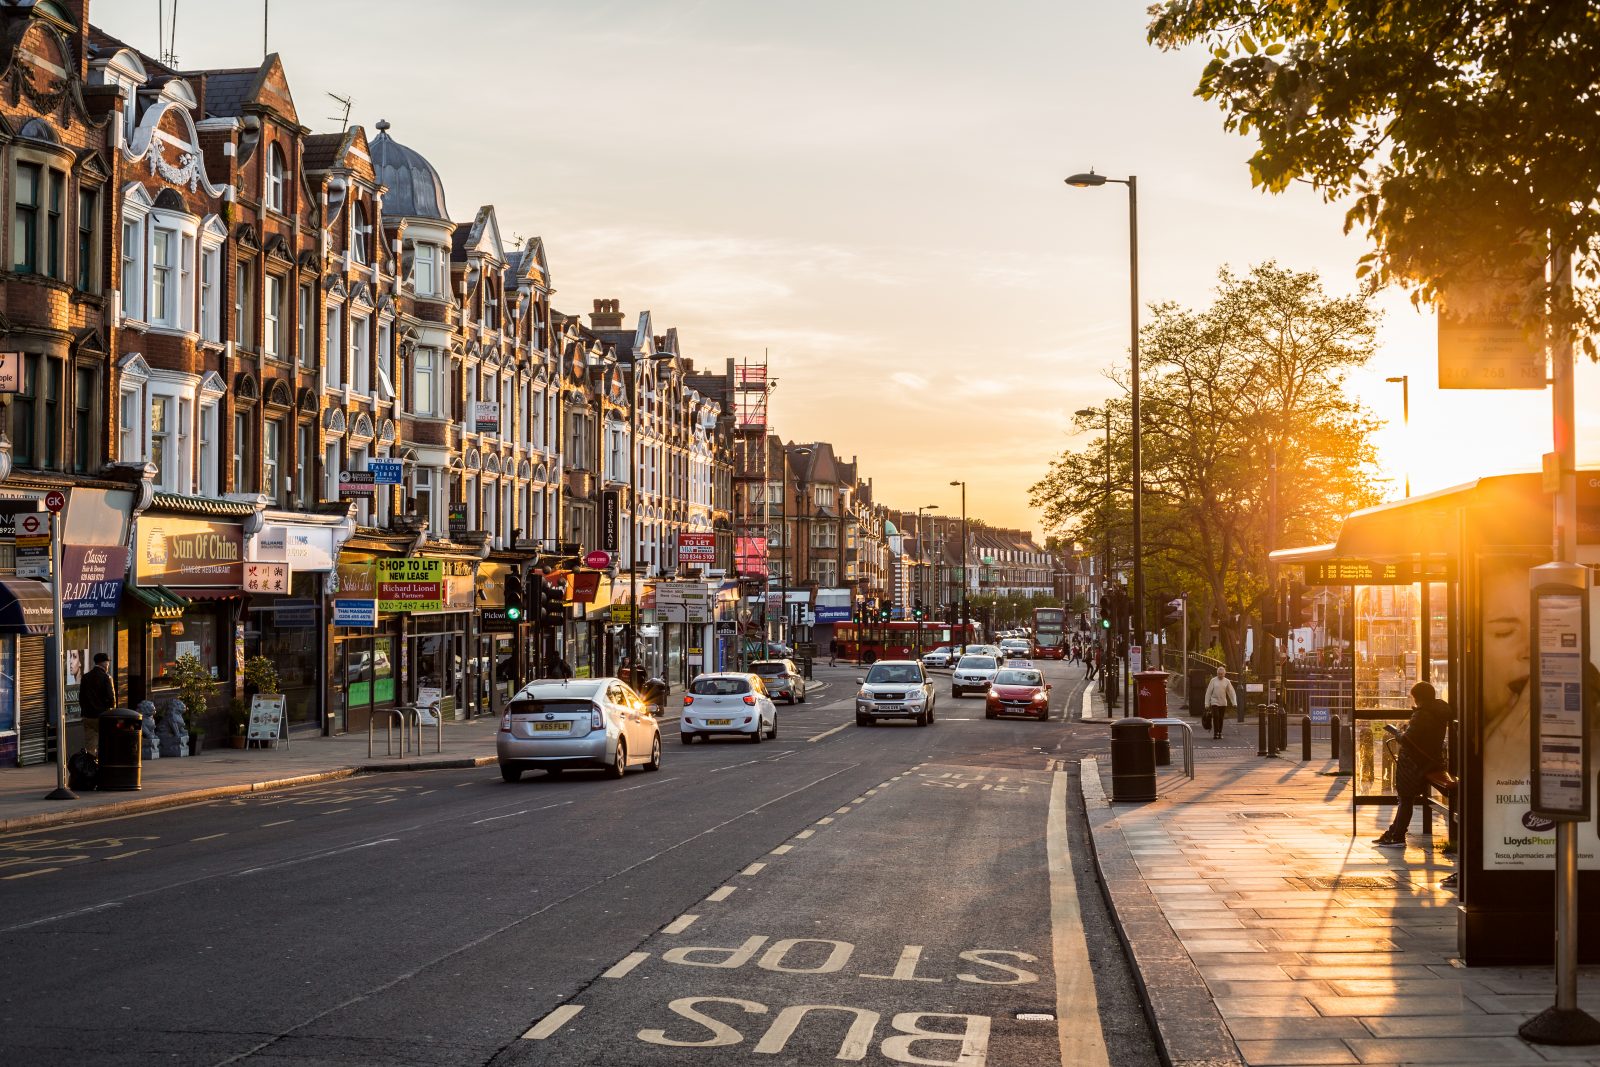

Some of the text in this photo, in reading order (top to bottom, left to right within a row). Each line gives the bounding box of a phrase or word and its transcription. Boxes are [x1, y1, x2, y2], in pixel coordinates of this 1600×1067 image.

[1483, 367, 1505, 378] 268
[47, 497, 61, 506] GK
[173, 534, 237, 560] Sun Of China
[83, 549, 107, 564] Classics
[94, 565, 106, 573] Beauty
[201, 565, 231, 574] RESTAURANT
[379, 560, 405, 571] SHOP
[408, 560, 419, 571] TO
[423, 560, 439, 571] LET
[389, 572, 429, 580] NEW LEASE
[63, 582, 118, 600] RADIANCE
[383, 584, 436, 592] Richard Lionel
[379, 602, 417, 610] 020-7487
[420, 602, 439, 610] 4451
[661, 936, 1040, 986] STOP
[637, 996, 992, 1067] BUS
